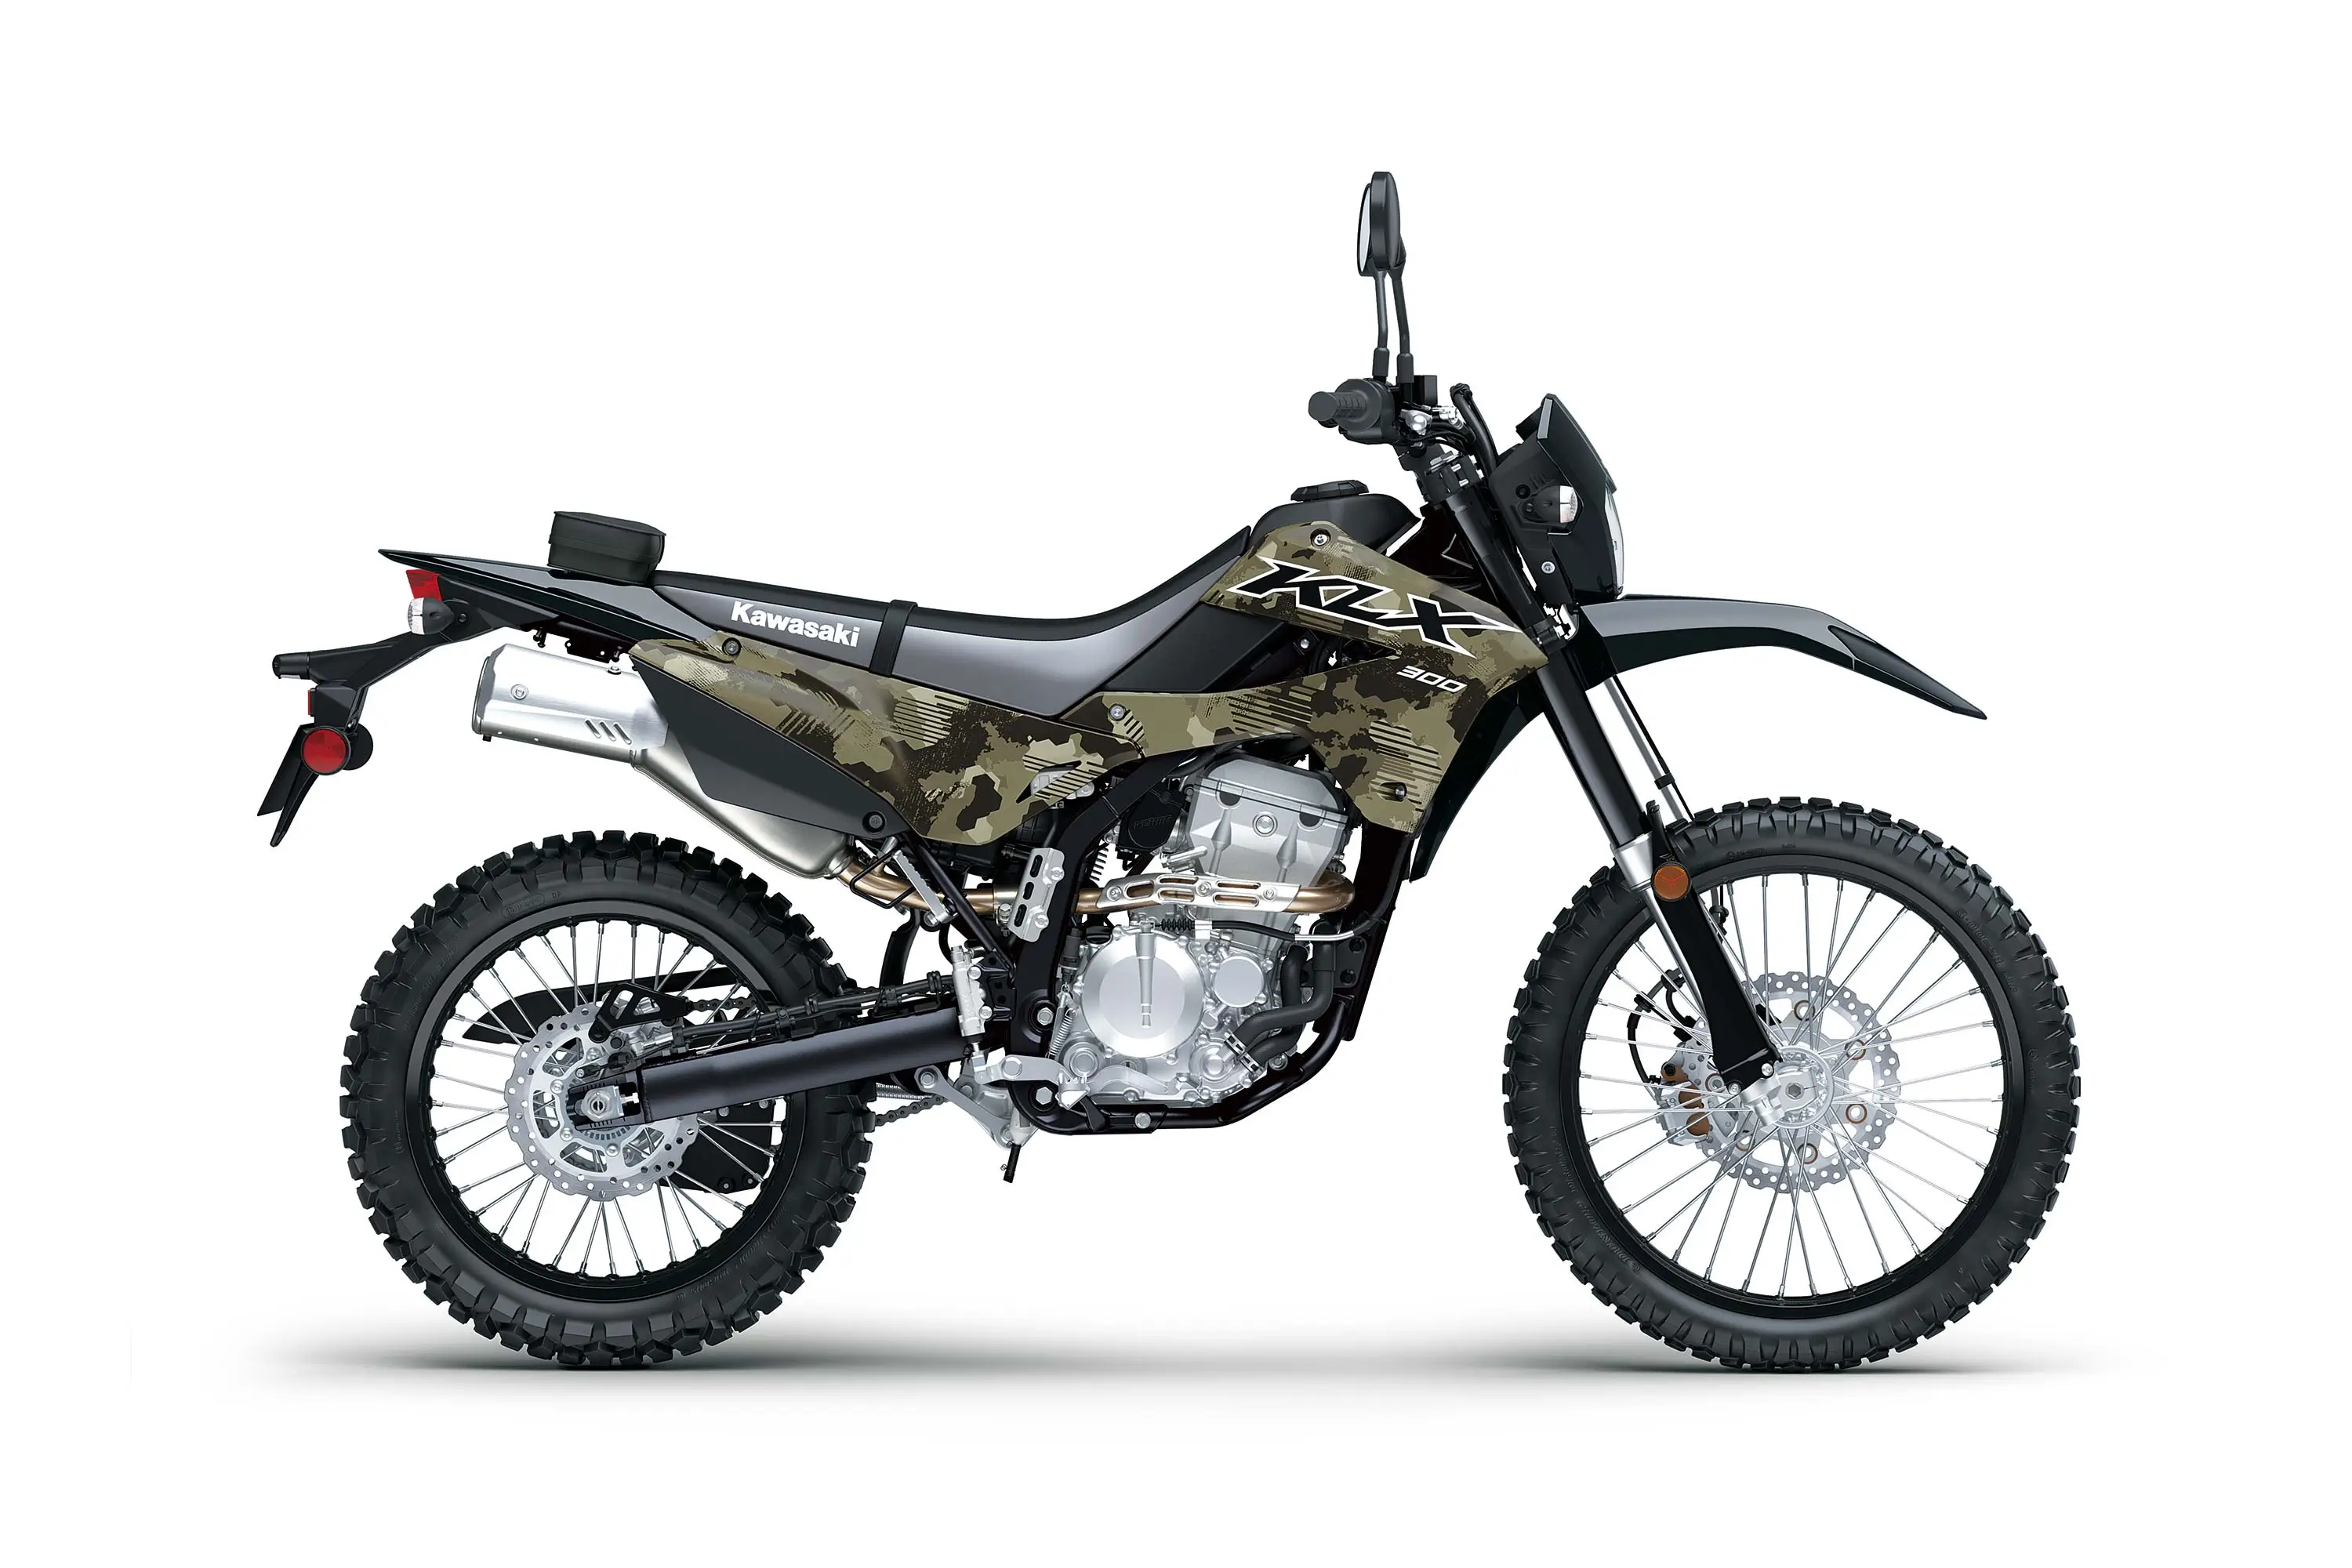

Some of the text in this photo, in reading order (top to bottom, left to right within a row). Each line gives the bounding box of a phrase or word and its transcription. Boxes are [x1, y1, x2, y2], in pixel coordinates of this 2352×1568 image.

[731, 601, 861, 648] Kawasaki
[1225, 555, 1524, 659] KLX
[1396, 665, 1468, 693] 300
